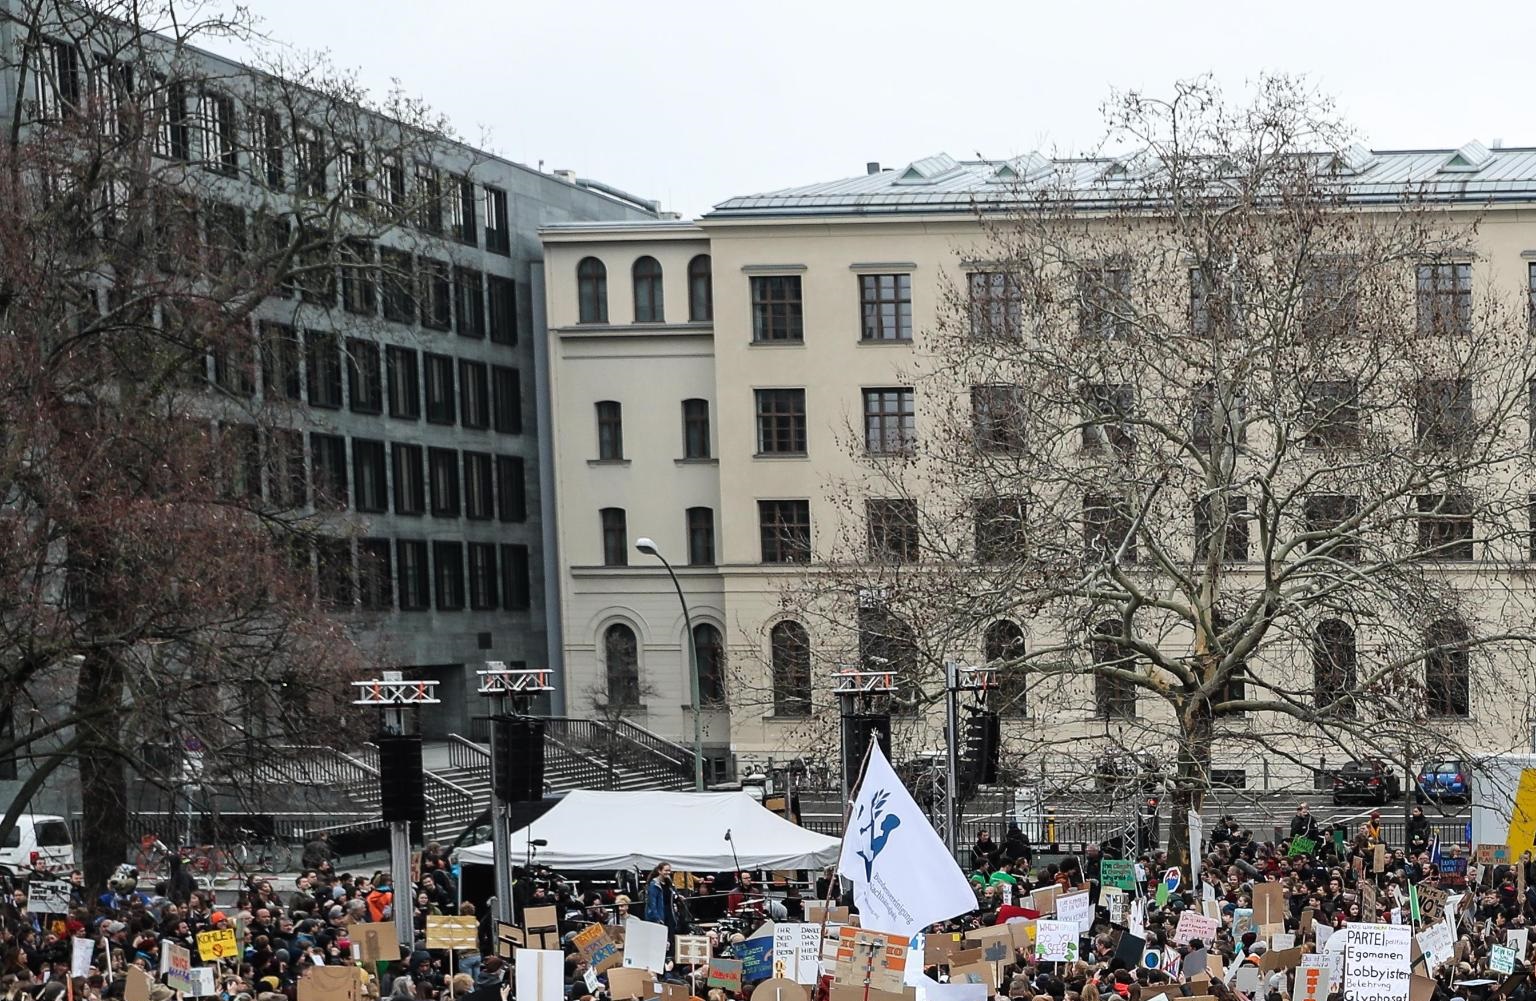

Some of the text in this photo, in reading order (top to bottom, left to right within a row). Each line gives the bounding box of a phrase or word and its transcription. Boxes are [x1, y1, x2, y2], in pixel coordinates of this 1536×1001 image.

[198, 930, 233, 944] KOHLE?
[1347, 930, 1385, 946] PARTEI
[1347, 948, 1403, 966] Egomanen
[1346, 963, 1411, 980] Lobbyisten
[1346, 978, 1391, 991] Belehrung
